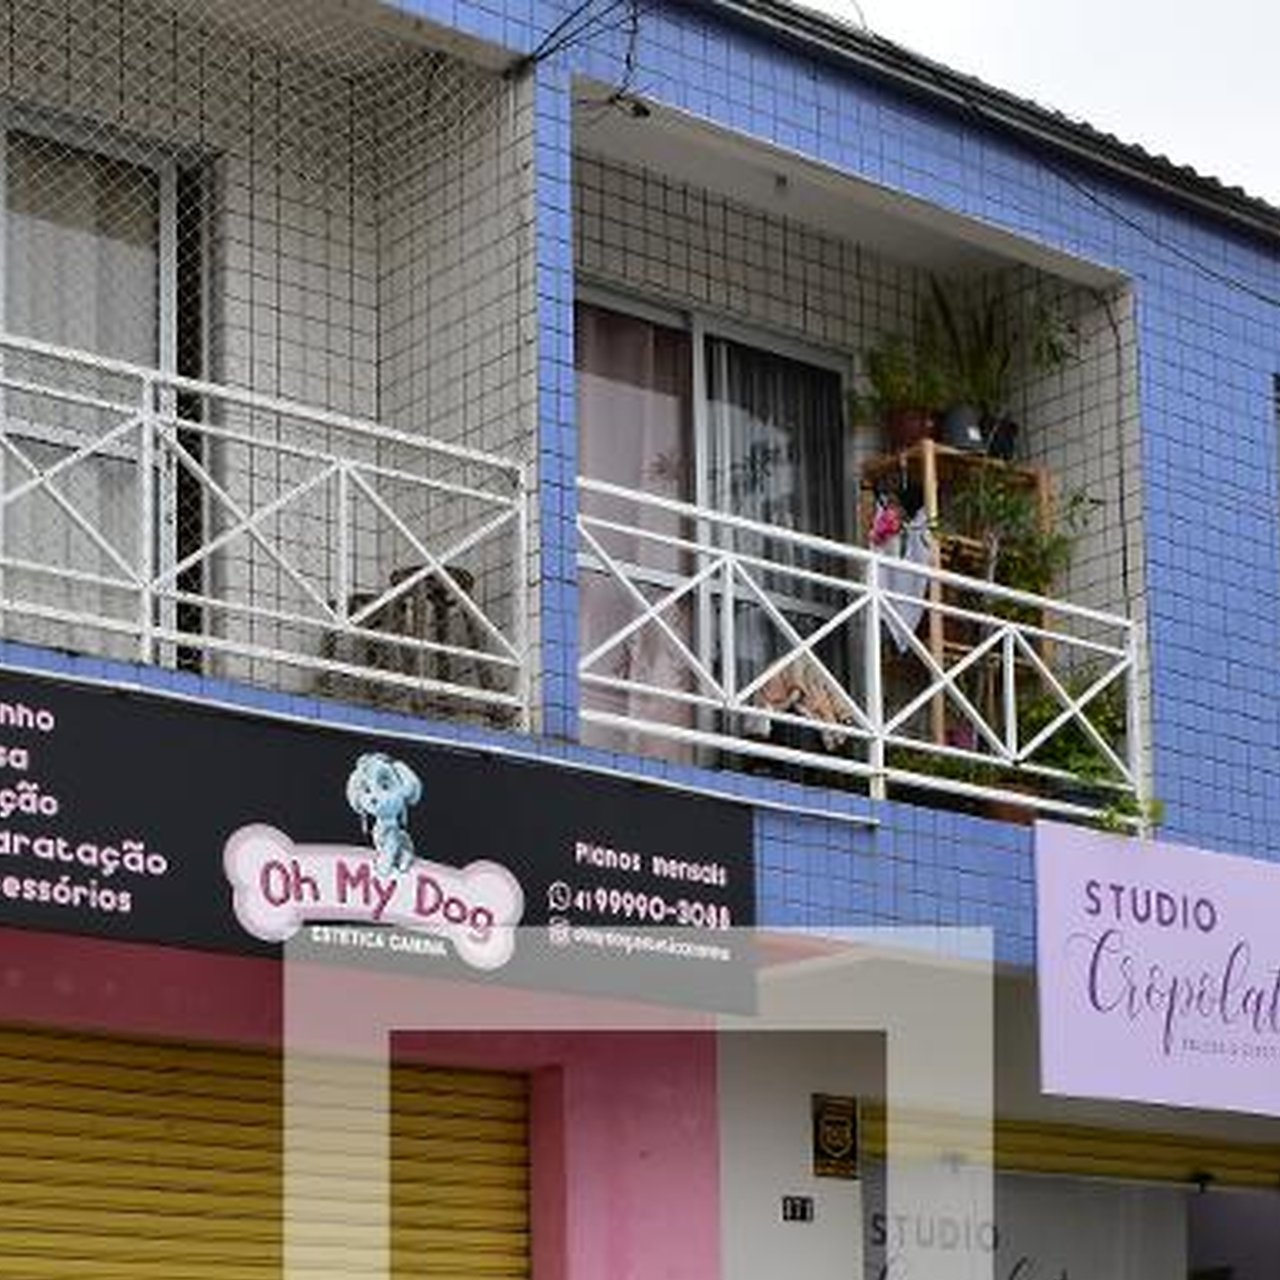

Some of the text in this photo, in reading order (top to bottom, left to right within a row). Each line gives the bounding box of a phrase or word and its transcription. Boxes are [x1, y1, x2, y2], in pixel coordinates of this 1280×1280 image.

[575, 842, 727, 886] Planos mensais
[259, 858, 495, 944] Oh My Dog
[1084, 879, 1218, 933] STUDIO
[871, 1216, 1000, 1251] STUDIO
